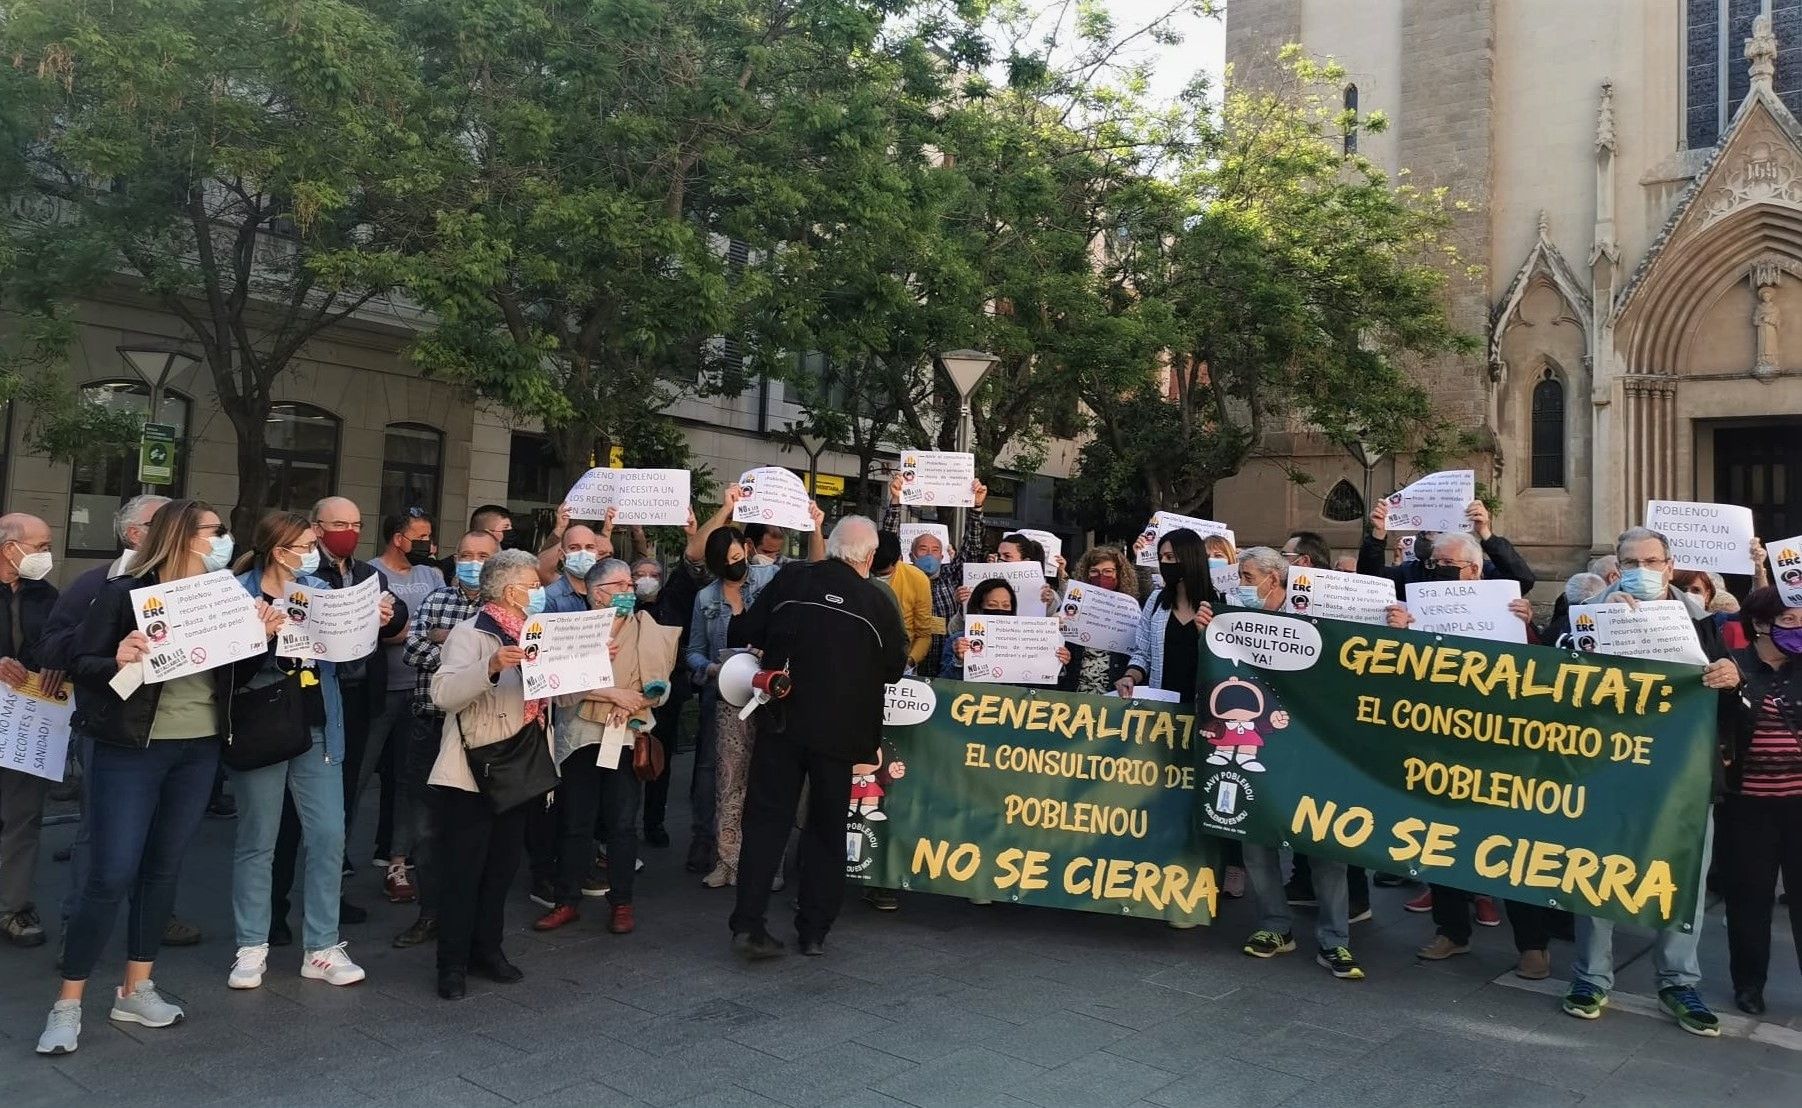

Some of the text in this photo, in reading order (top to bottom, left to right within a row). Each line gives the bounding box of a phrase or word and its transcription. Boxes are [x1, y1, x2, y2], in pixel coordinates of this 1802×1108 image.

[620, 473, 665, 481] POBLENOU
[903, 488, 911, 496] NO
[619, 499, 679, 507] CONSULTORIO
[738, 505, 747, 513] NO
[619, 512, 647, 520] DIGNO
[1655, 505, 1718, 517] POBLENOU
[1654, 522, 1729, 534] NECESITA UN
[1669, 538, 1736, 550] NSULTORIO
[1141, 550, 1149, 558] NO
[1694, 556, 1718, 565] YA!!
[1777, 557, 1801, 567] ERC
[175, 584, 191, 592] Abrir
[1293, 584, 1311, 592] ERC
[1419, 586, 1476, 598] Sra. ALBA
[289, 596, 308, 608] ERC
[1068, 594, 1081, 602] ERC
[1323, 593, 1350, 601] recursos
[143, 607, 165, 619] ERC
[180, 602, 207, 615] recursos
[222, 606, 249, 616] mentiras
[1479, 622, 1494, 631] SU
[1610, 617, 1648, 625] ¡PobleNou
[185, 625, 217, 638] tomadura
[228, 617, 245, 628] pelo!
[1231, 621, 1300, 639] ¡ABRIR EL
[1576, 624, 1595, 632] ERC
[1611, 627, 1645, 635] recursos
[1649, 624, 1680, 632] servicios
[283, 634, 294, 644] NO
[526, 632, 542, 640] ERC
[1215, 632, 1315, 656] CONSULTORIO
[150, 653, 167, 669] NO
[1252, 652, 1272, 665] YA!
[968, 664, 977, 673] NO
[1340, 635, 1674, 716] GENERALITAT:
[902, 688, 916, 697] EL
[13, 698, 36, 764] RECORTES EN
[1356, 695, 1654, 766] EL CONSULTORIO DE
[34, 718, 52, 769] SANIDAD!!
[965, 743, 1195, 790] EL CONSULTORIO DE
[1203, 771, 1255, 801] AAVV POBLENOU
[1404, 757, 1586, 819] POBLENOU
[1004, 794, 1148, 839] POBLENOU
[847, 823, 878, 848] POBLENOU
[1291, 795, 1678, 921] NO SE CIERRA
[911, 837, 1218, 918] NO SE CIERRA
